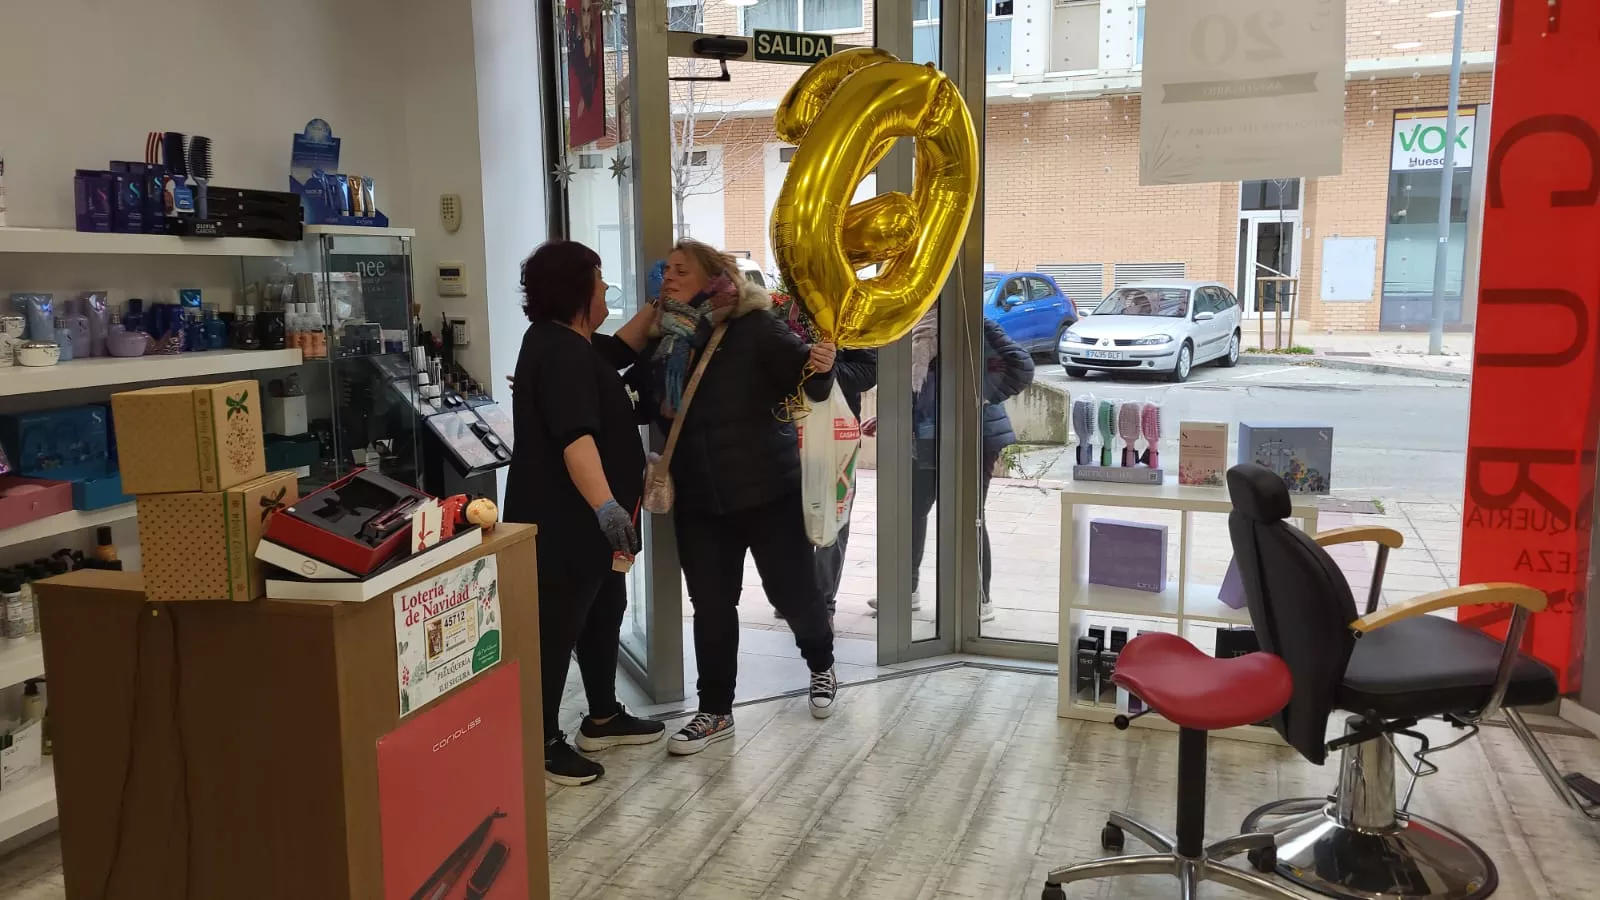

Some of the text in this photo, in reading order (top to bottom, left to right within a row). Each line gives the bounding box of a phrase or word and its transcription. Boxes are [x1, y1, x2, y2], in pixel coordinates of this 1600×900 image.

[757, 33, 829, 57] SALIDA
[356, 261, 386, 277] nee
[401, 582, 445, 613] Lotería
[405, 585, 470, 627] de Navidad
[444, 610, 465, 627] 45712
